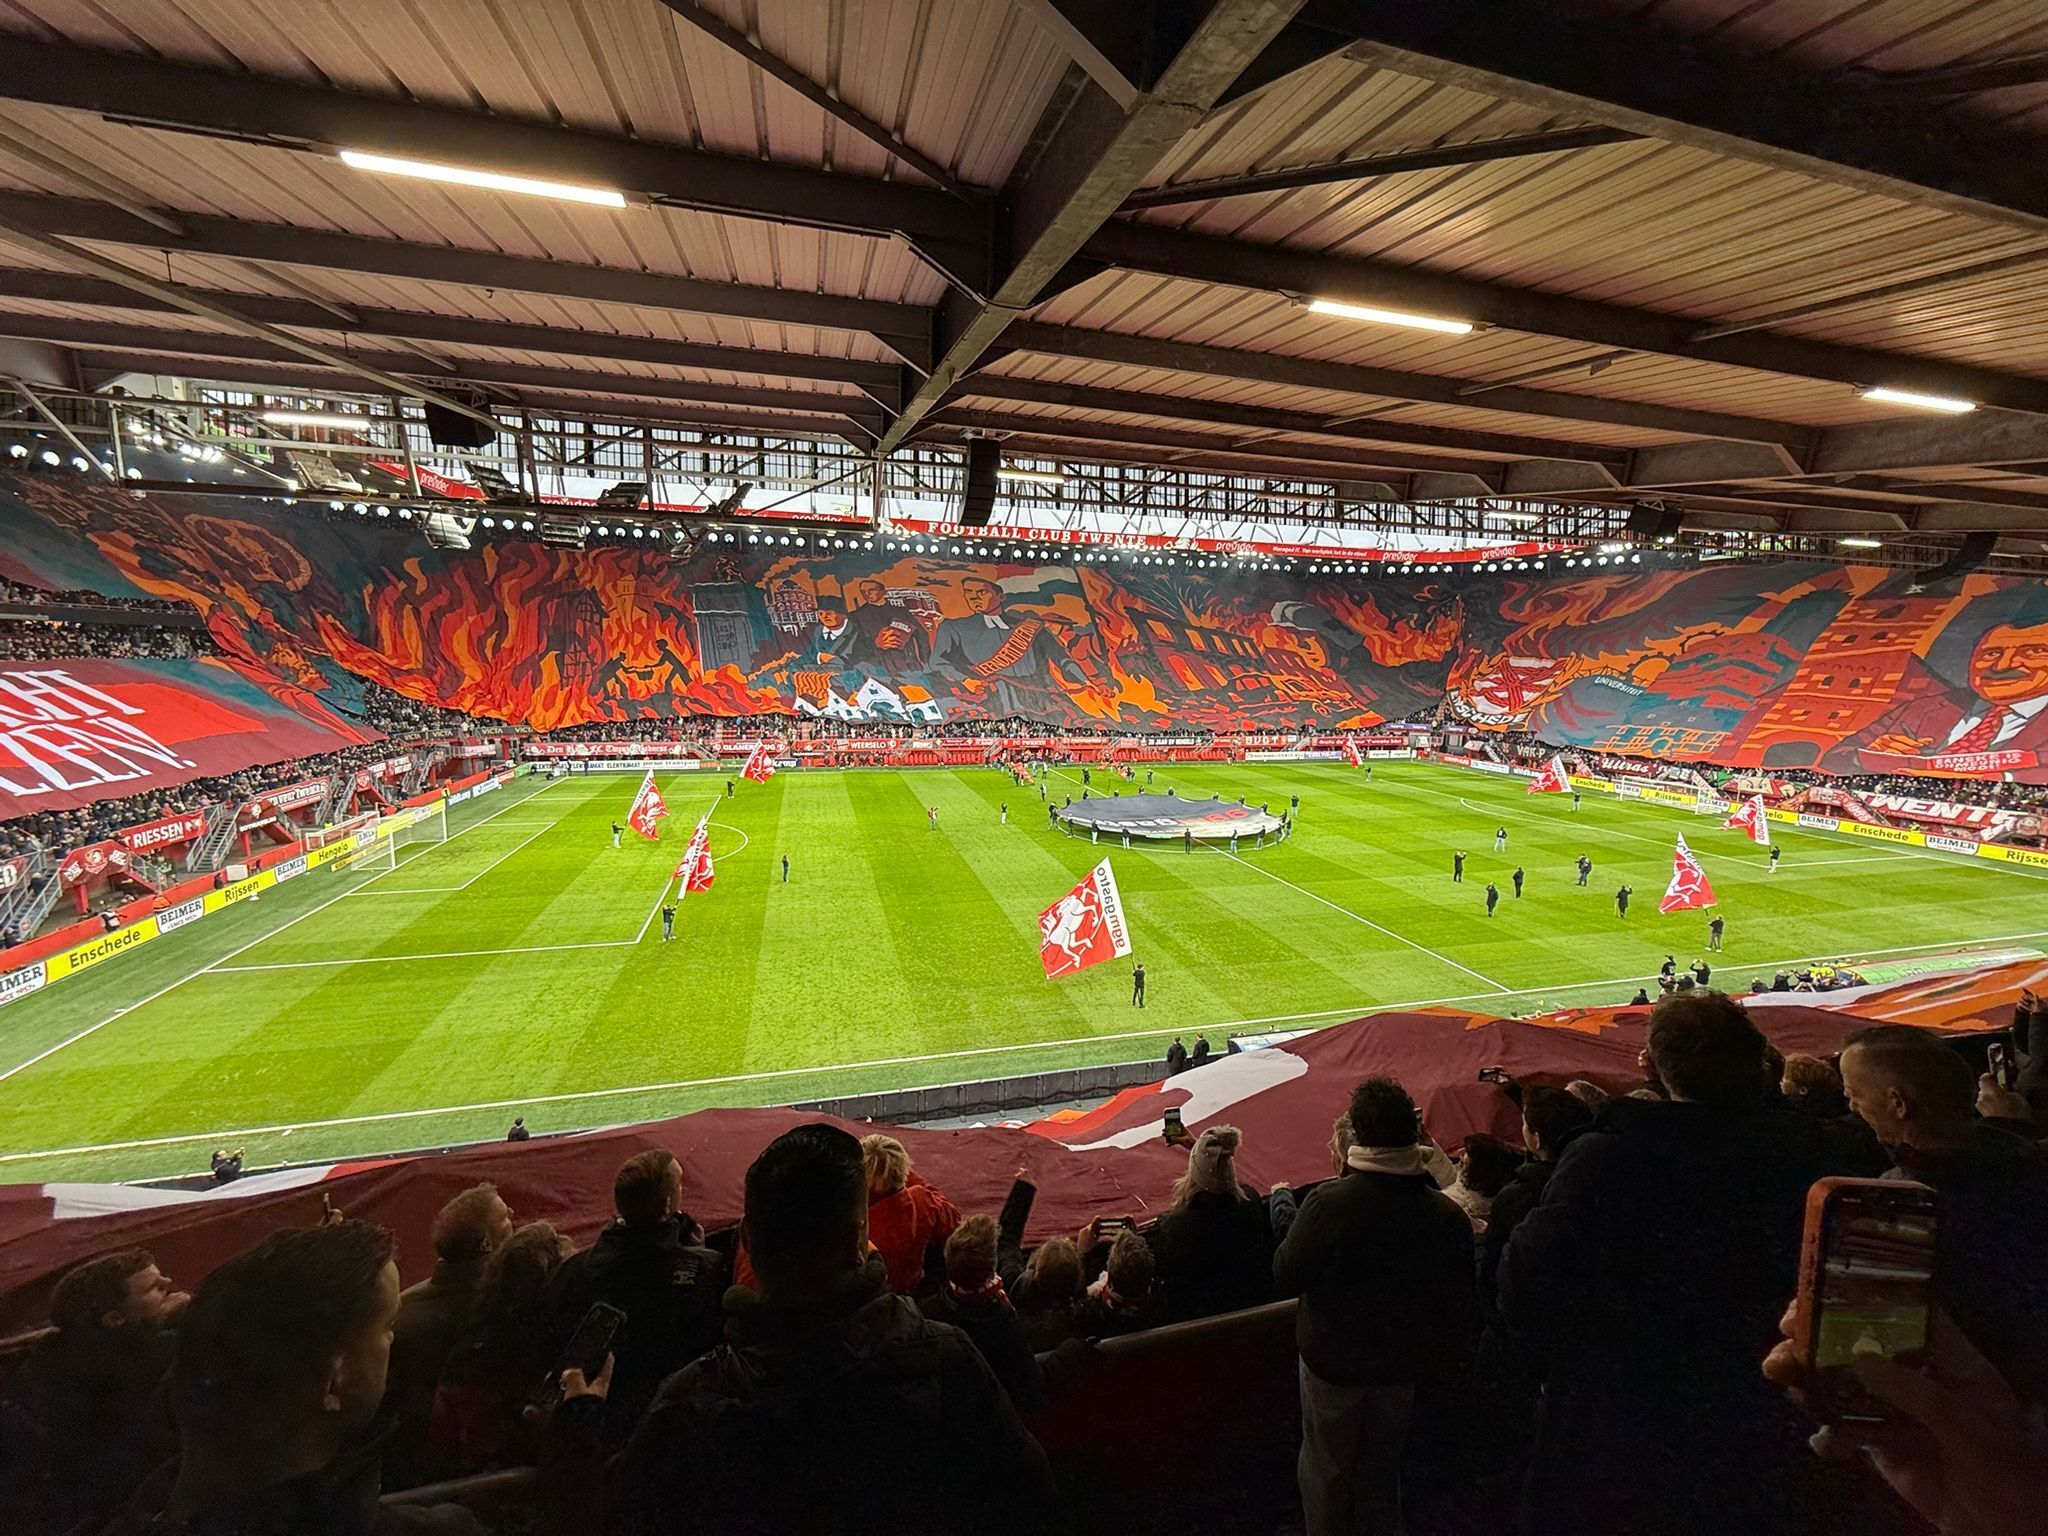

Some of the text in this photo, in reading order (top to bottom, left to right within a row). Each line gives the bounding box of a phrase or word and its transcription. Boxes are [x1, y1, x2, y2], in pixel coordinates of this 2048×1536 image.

[928, 521, 1146, 546] FOOTBALL CLUB TWENTE
[1594, 676, 1644, 696] UNIVERSITEIT
[1450, 690, 1528, 725] ENSCHEDE
[1601, 758, 1649, 774] Ultras
[1575, 779, 1606, 790] Enschede
[1800, 814, 1837, 828] BEIMER
[133, 821, 184, 848] RIESSEN
[1853, 825, 1909, 842] Enschede
[1928, 835, 1976, 851] BEIMER
[318, 842, 349, 861] Hengelo
[2006, 850, 2048, 866] Rijsse
[277, 858, 305, 875] BEIMER
[225, 880, 260, 902] Rijssen
[160, 898, 202, 926] BEIMER
[69, 930, 141, 968] Enschede
[0, 966, 43, 993] IMER
